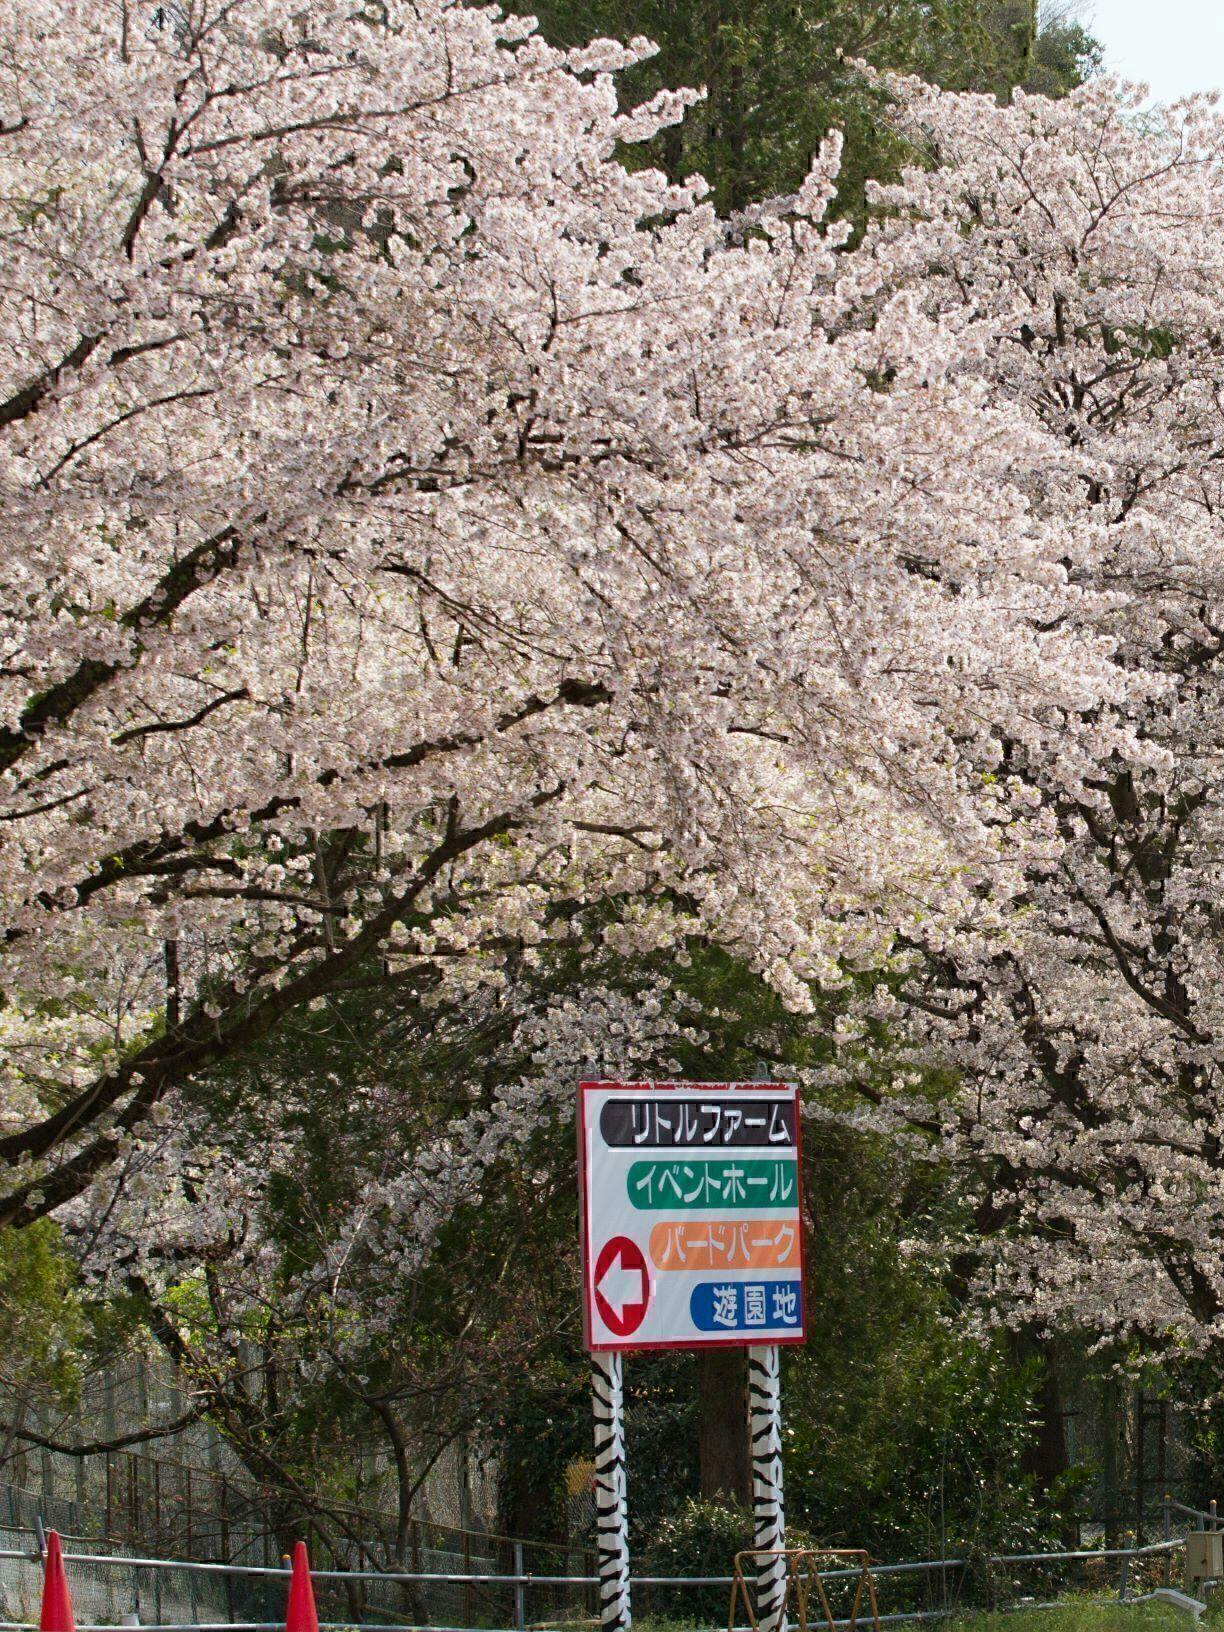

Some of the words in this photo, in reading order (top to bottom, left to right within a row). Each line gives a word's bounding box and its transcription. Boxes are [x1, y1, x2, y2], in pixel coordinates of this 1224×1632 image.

[631, 1103, 791, 1144] リトルファーム
[636, 1162, 793, 1204] イベントホール
[661, 1223, 795, 1266] バードパーク
[712, 1285, 798, 1328] 遊園地
